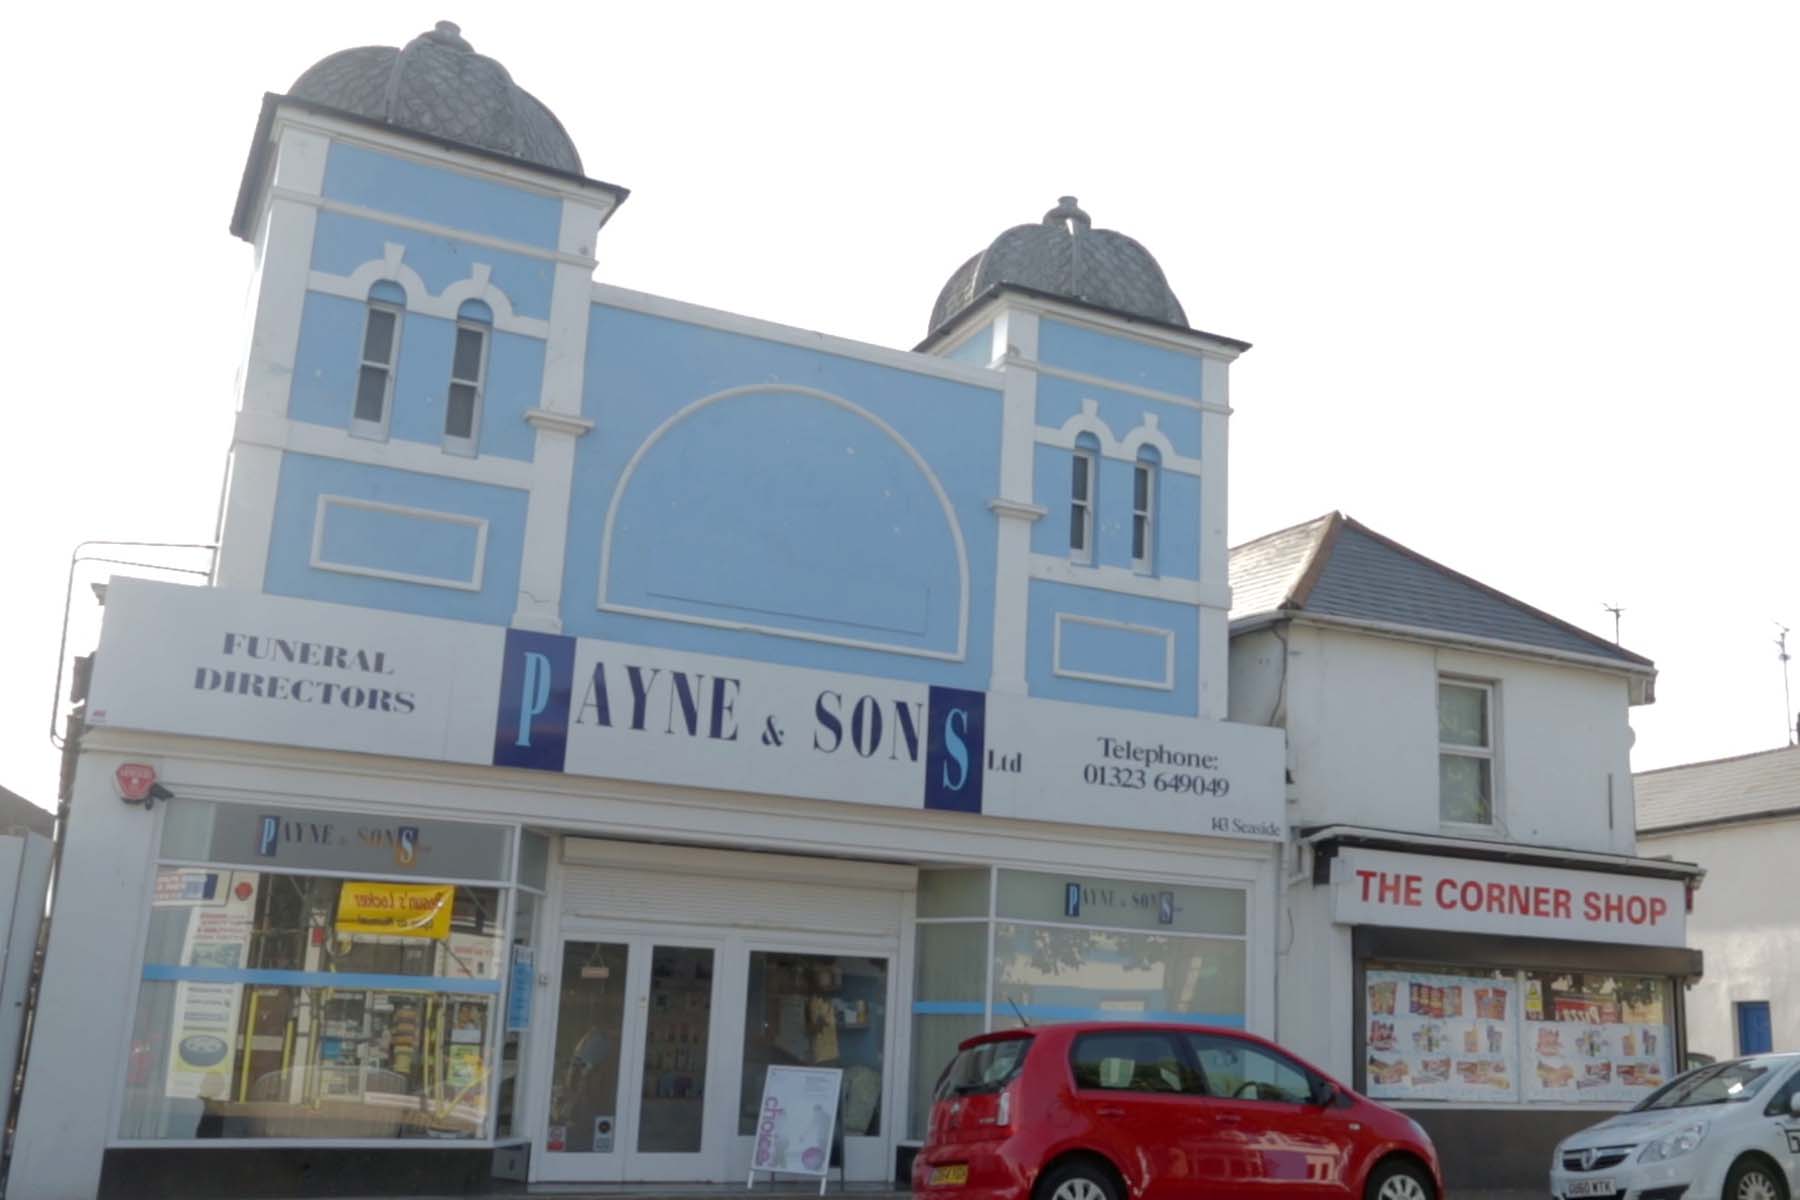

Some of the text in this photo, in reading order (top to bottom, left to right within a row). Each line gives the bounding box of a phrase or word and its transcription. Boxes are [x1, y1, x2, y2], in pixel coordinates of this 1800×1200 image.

[222, 631, 396, 676] FUNERAL
[194, 667, 416, 715] DIRECTORS
[515, 652, 1022, 791] PAYNE & SONS Ltd
[1097, 737, 1219, 771] Telephone:
[1083, 763, 1230, 797] 01323 649049
[261, 816, 334, 855] PAYNE
[1232, 817, 1281, 837] Seaside
[1356, 869, 1668, 926] THE CORNER SHOP
